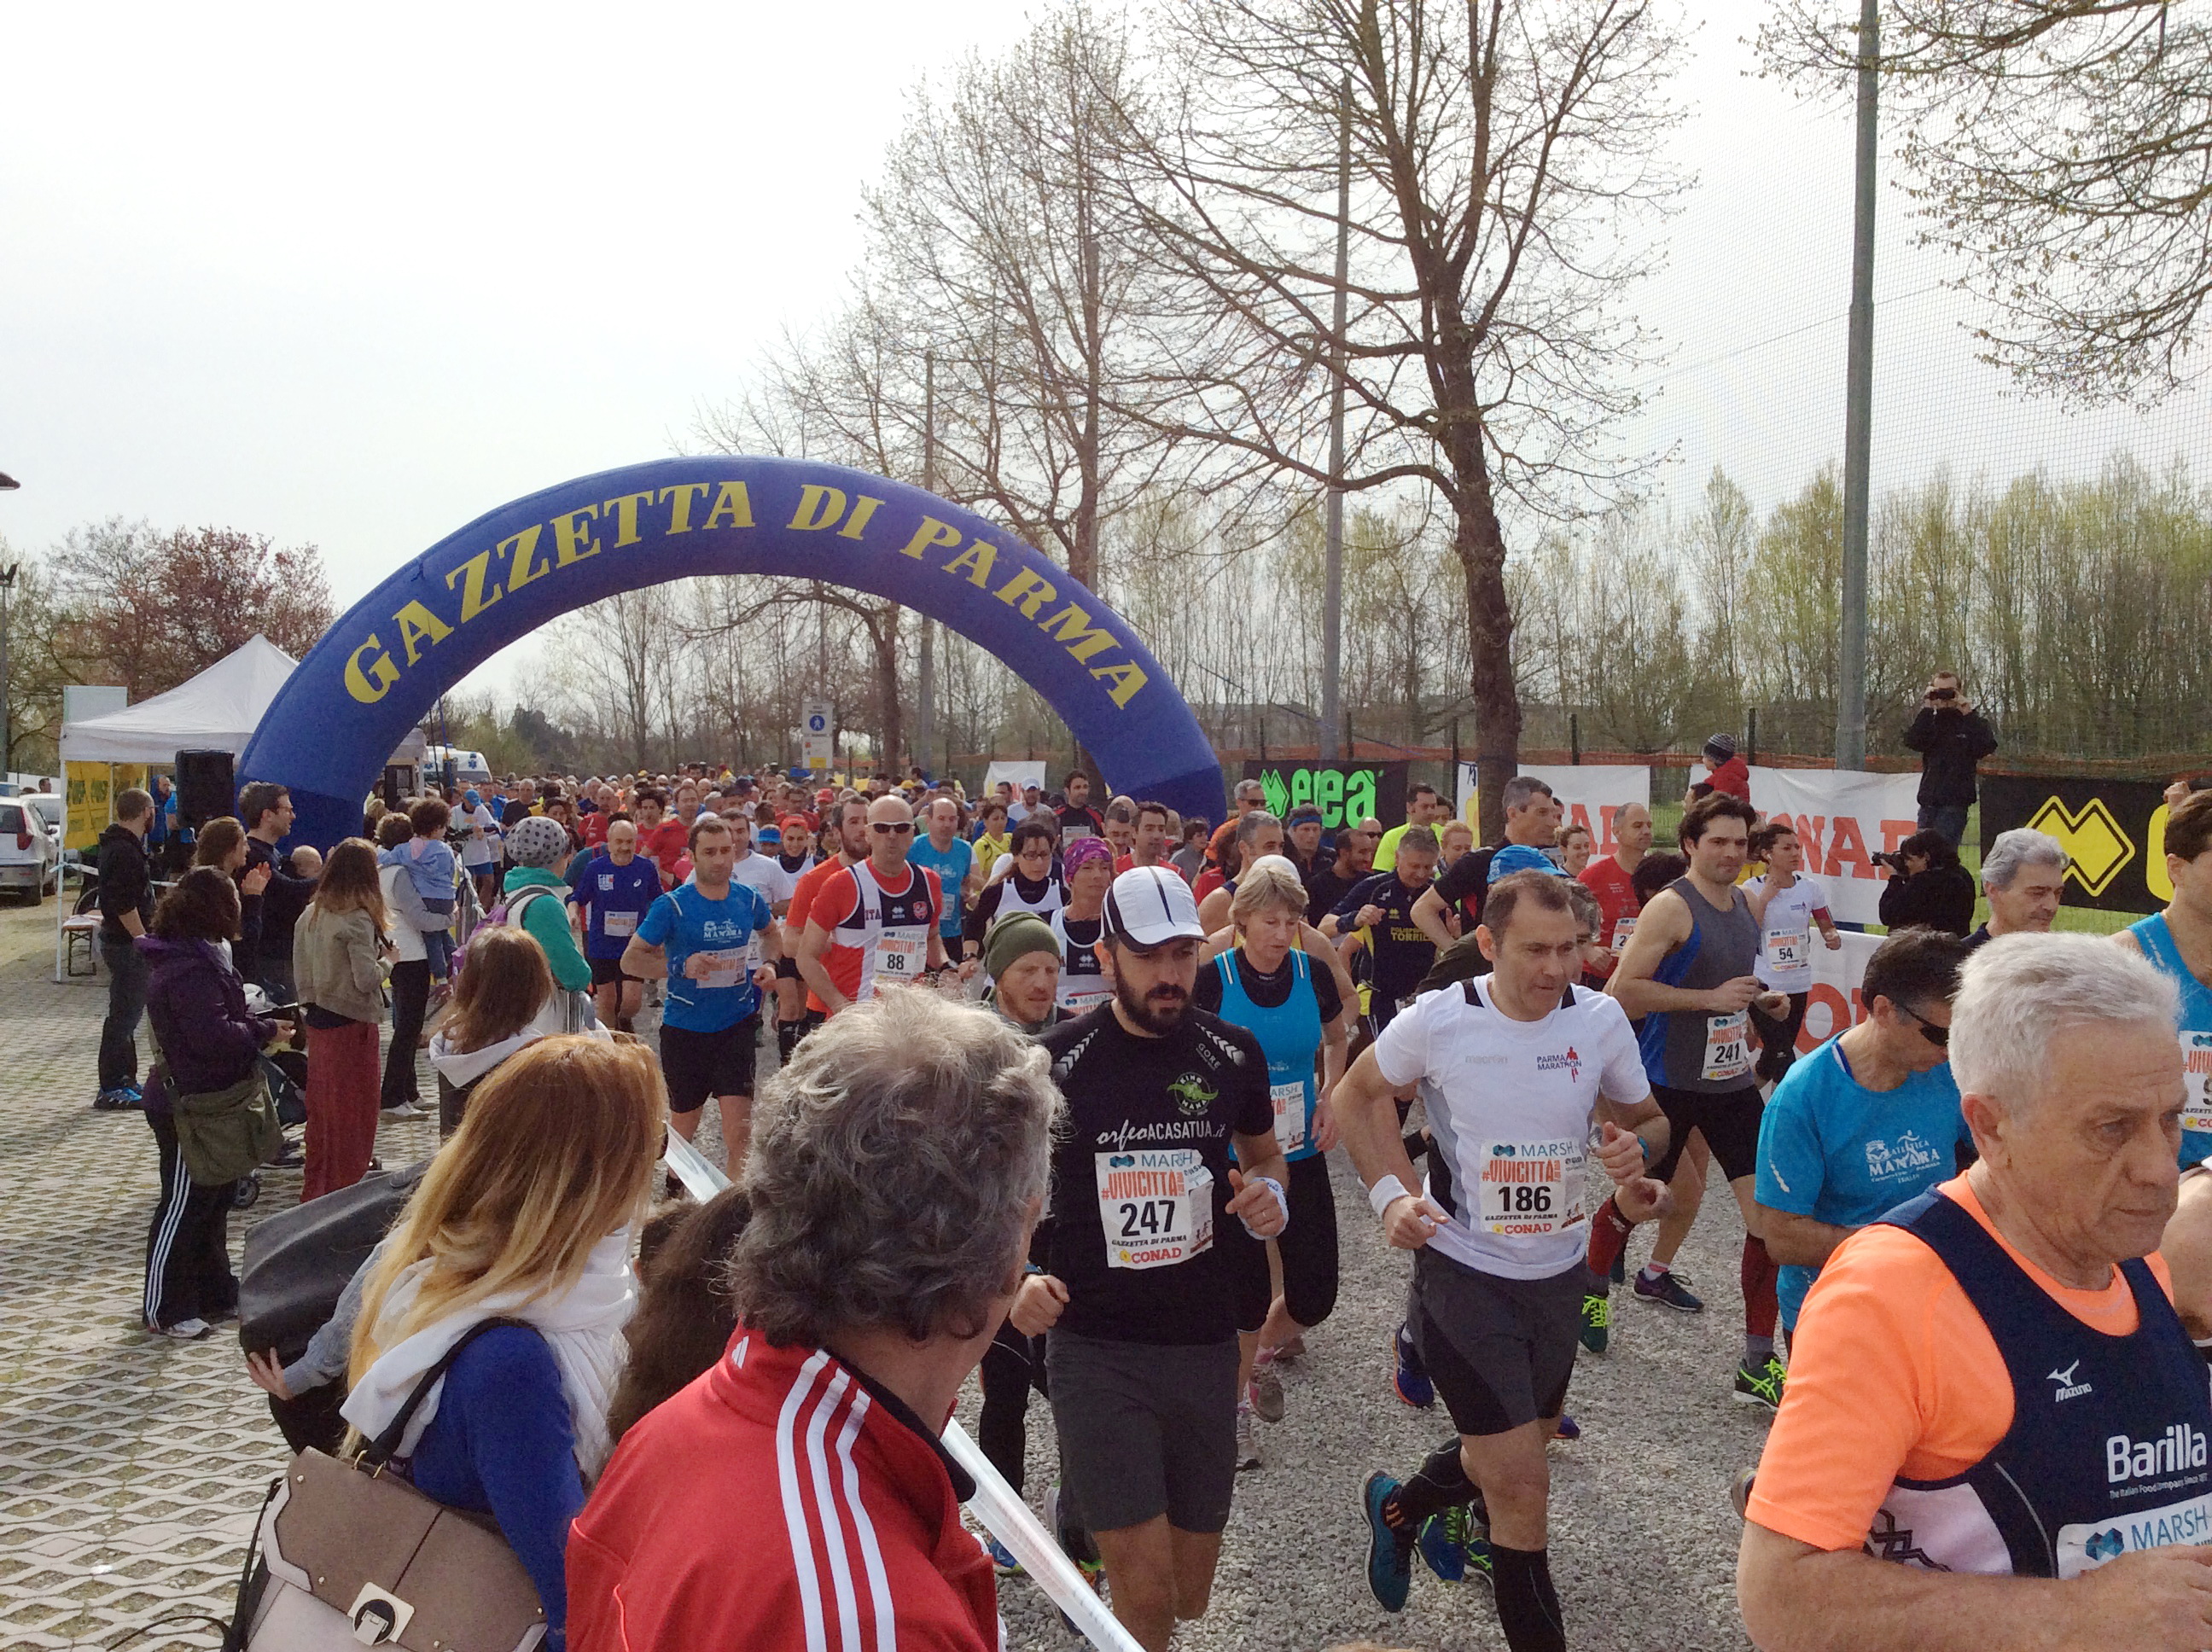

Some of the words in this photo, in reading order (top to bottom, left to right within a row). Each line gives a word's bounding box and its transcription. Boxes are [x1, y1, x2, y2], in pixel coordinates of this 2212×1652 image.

[344, 480, 756, 704] GAZZETTA
[786, 484, 886, 540] DI
[899, 515, 1149, 710] PARMA
[887, 953, 905, 970] 88
[1779, 947, 1793, 960] 54
[1198, 1043, 1220, 1068] GORE
[1537, 1054, 1567, 1063] PARMA
[1714, 1042, 1739, 1063] 241
[1538, 1060, 1581, 1071] MARATHON
[1270, 1085, 1298, 1098] ARSH
[1521, 1141, 1575, 1157] MARSH
[1869, 1149, 1941, 1177] MANARA
[1498, 1185, 1551, 1212] 186
[1120, 1200, 1176, 1237] 247
[1505, 1223, 1552, 1235] CONAD
[1111, 1239, 1149, 1248] GAZZETTA
[1161, 1234, 1187, 1244] PARMA
[1131, 1247, 1182, 1265] CONAD
[2106, 1422, 2208, 1483] Barilla
[2131, 1504, 2209, 1551] MARSH
